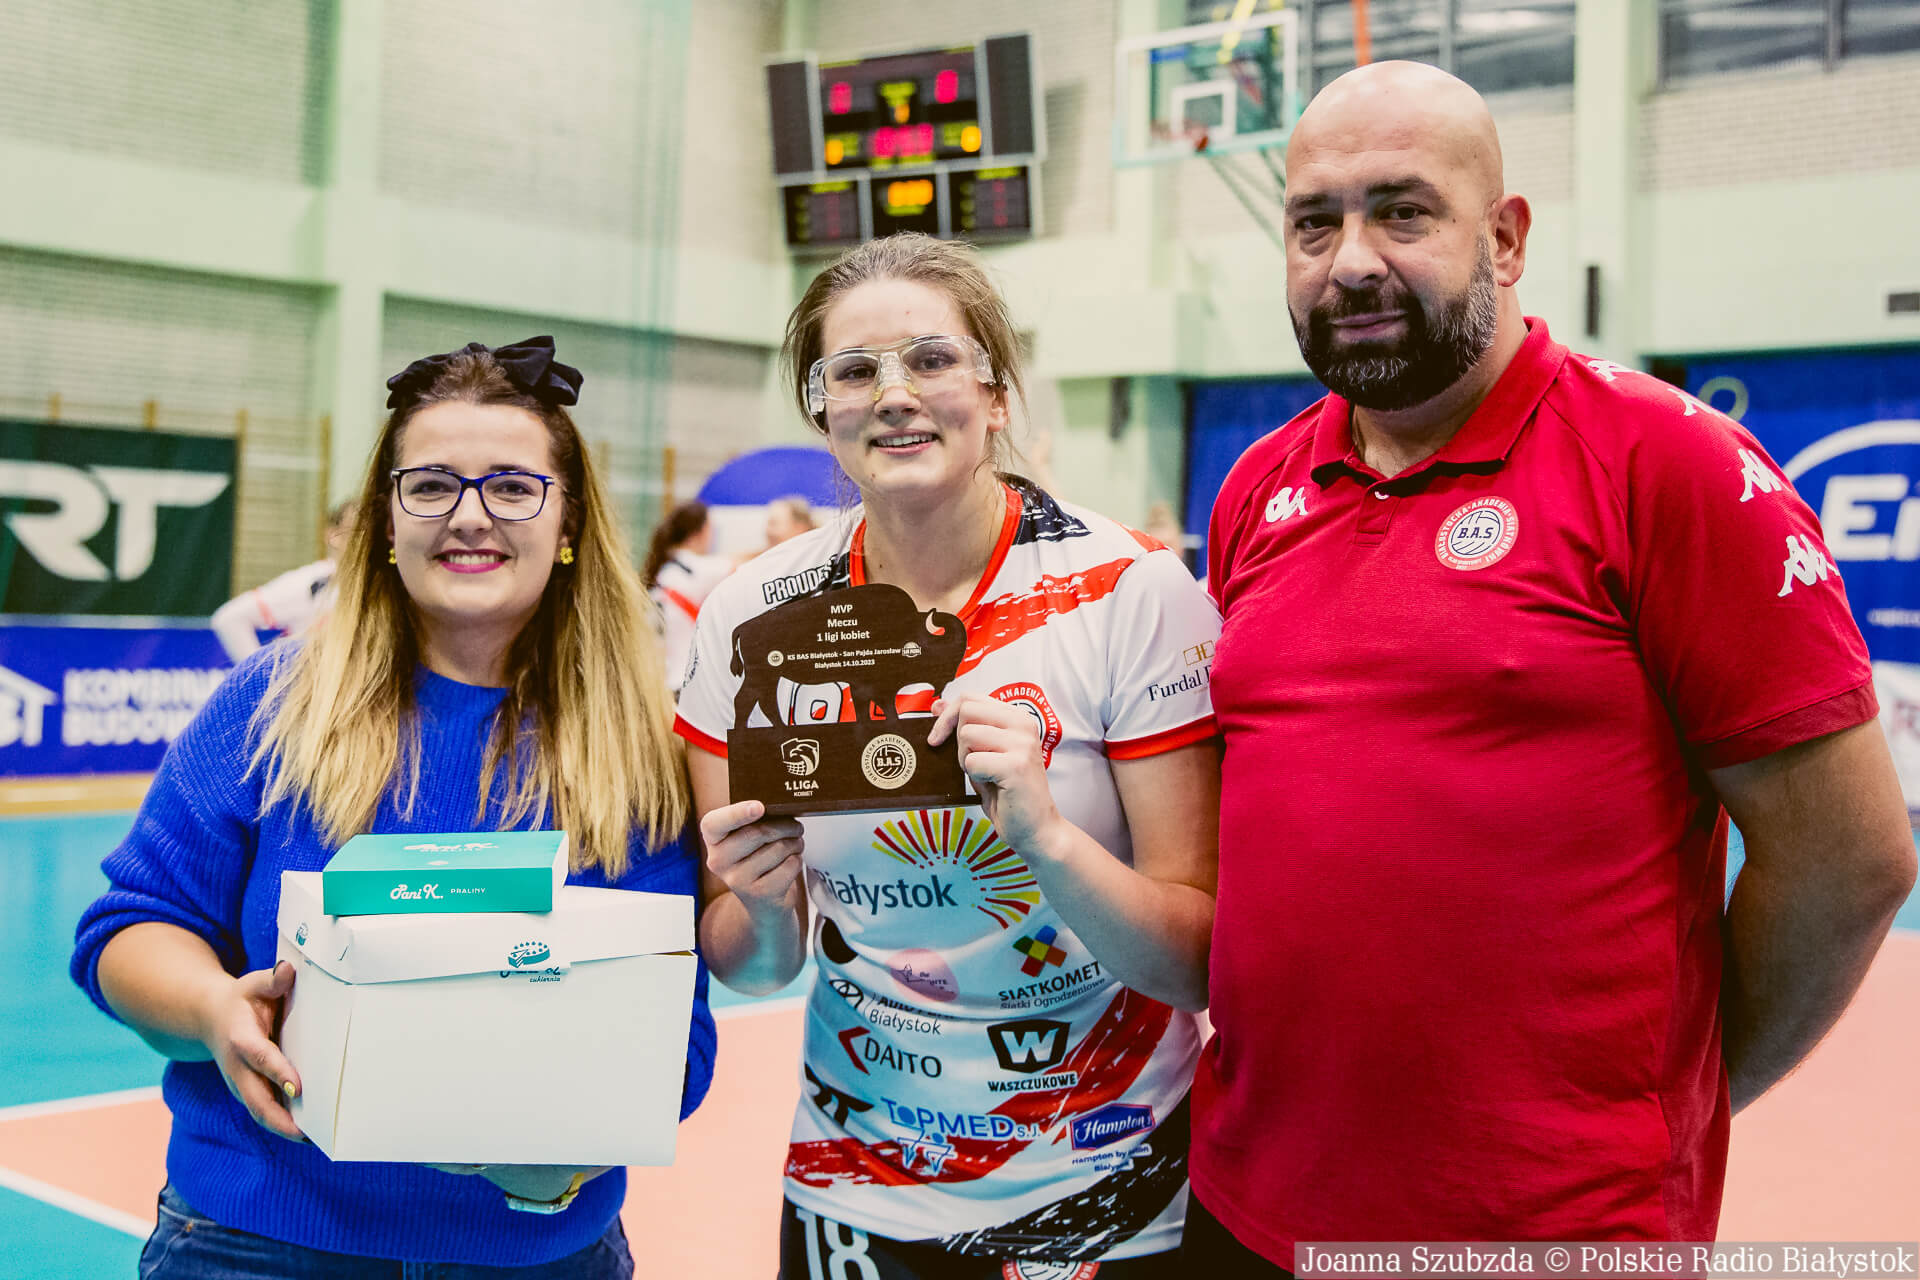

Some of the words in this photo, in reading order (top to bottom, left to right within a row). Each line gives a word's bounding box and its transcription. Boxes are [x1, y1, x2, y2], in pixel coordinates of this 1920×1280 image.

[1457, 526, 1494, 539] B.A.S
[830, 604, 853, 614] MVP
[827, 618, 858, 628] Meczu
[817, 633, 823, 642] 1
[825, 631, 839, 643] ligi
[841, 630, 870, 641] kobiet
[810, 651, 838, 660] Białystok
[856, 648, 873, 658] Pajda
[874, 647, 901, 655] Jarosław
[814, 660, 842, 670] Białystok
[843, 658, 875, 667] 14.10.2023
[1148, 669, 1202, 702] Furdal
[792, 780, 819, 790] LIGA
[390, 883, 423, 900] Pani
[998, 961, 1101, 1001] SIATKOMET
[869, 1008, 941, 1034] Białystok
[864, 1037, 942, 1078] DAITO
[987, 1073, 1076, 1092] WASZCZUKOWE
